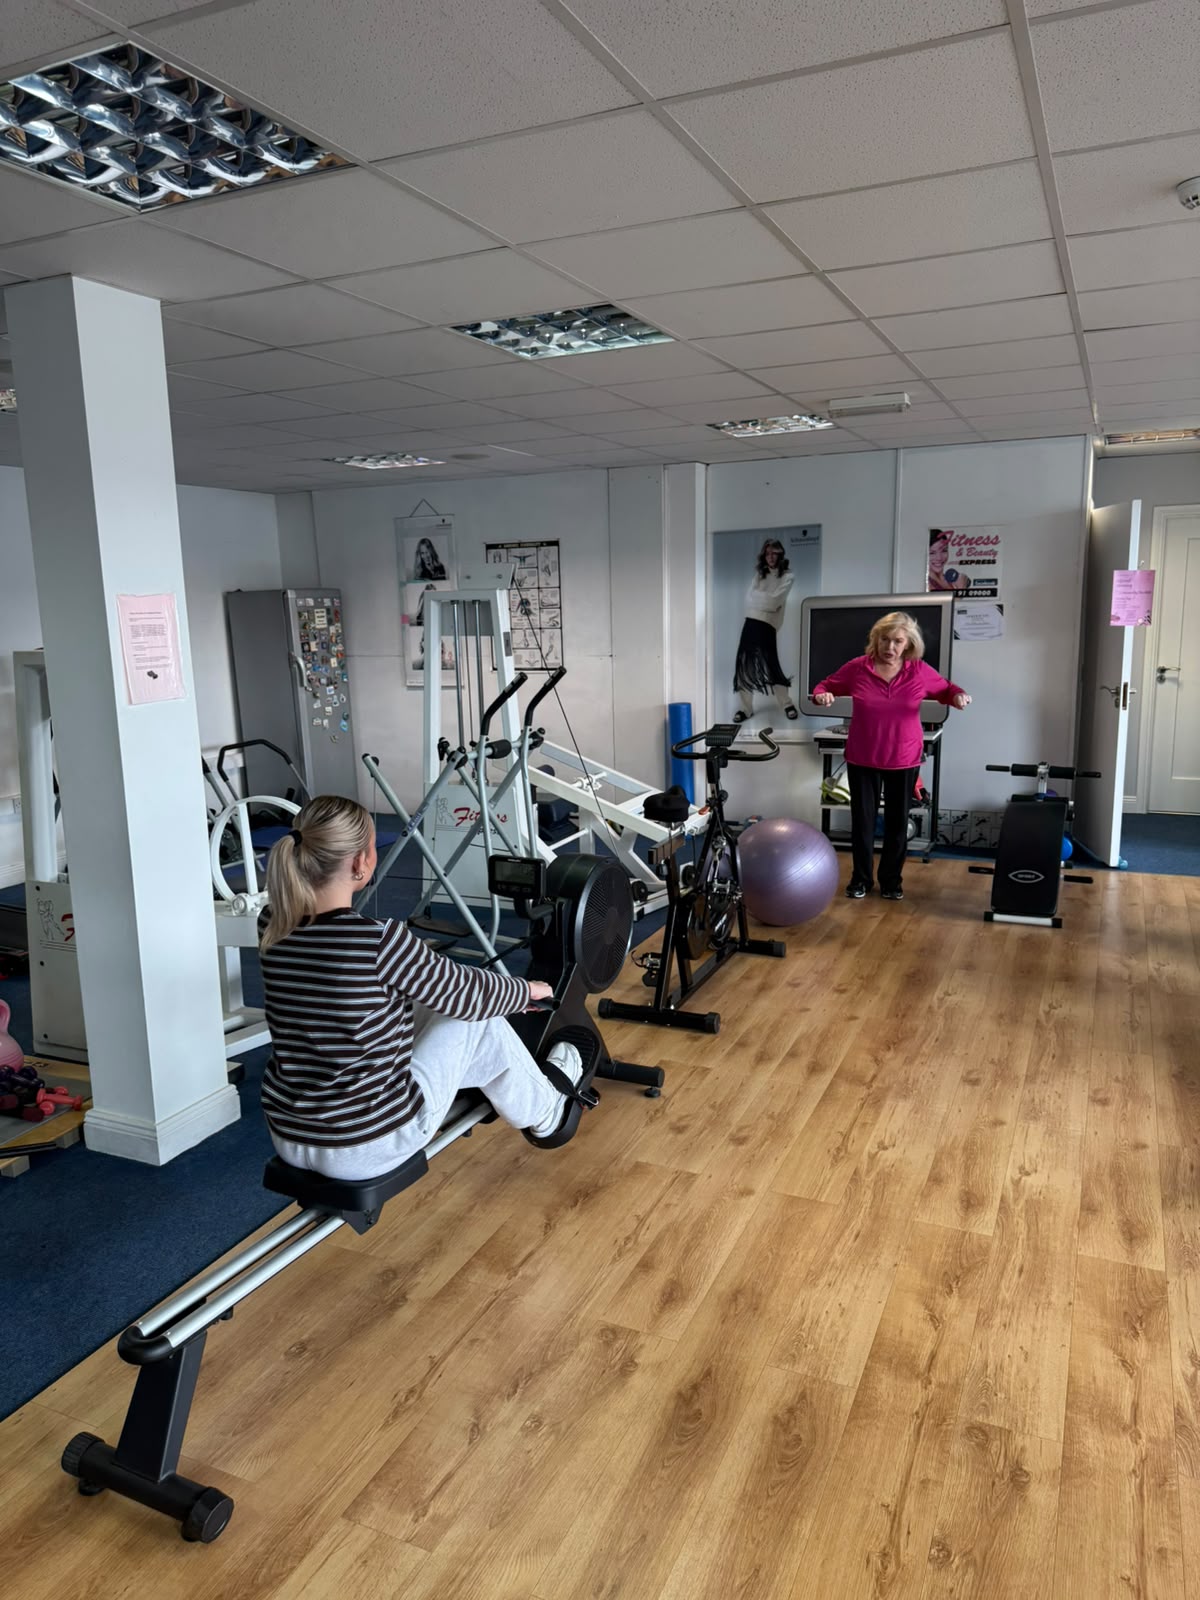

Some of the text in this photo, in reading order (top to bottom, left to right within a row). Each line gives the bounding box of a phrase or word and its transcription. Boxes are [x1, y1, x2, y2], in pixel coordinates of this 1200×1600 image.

[936, 530, 1001, 550] Fitness
[956, 546, 998, 559] & Beauty
